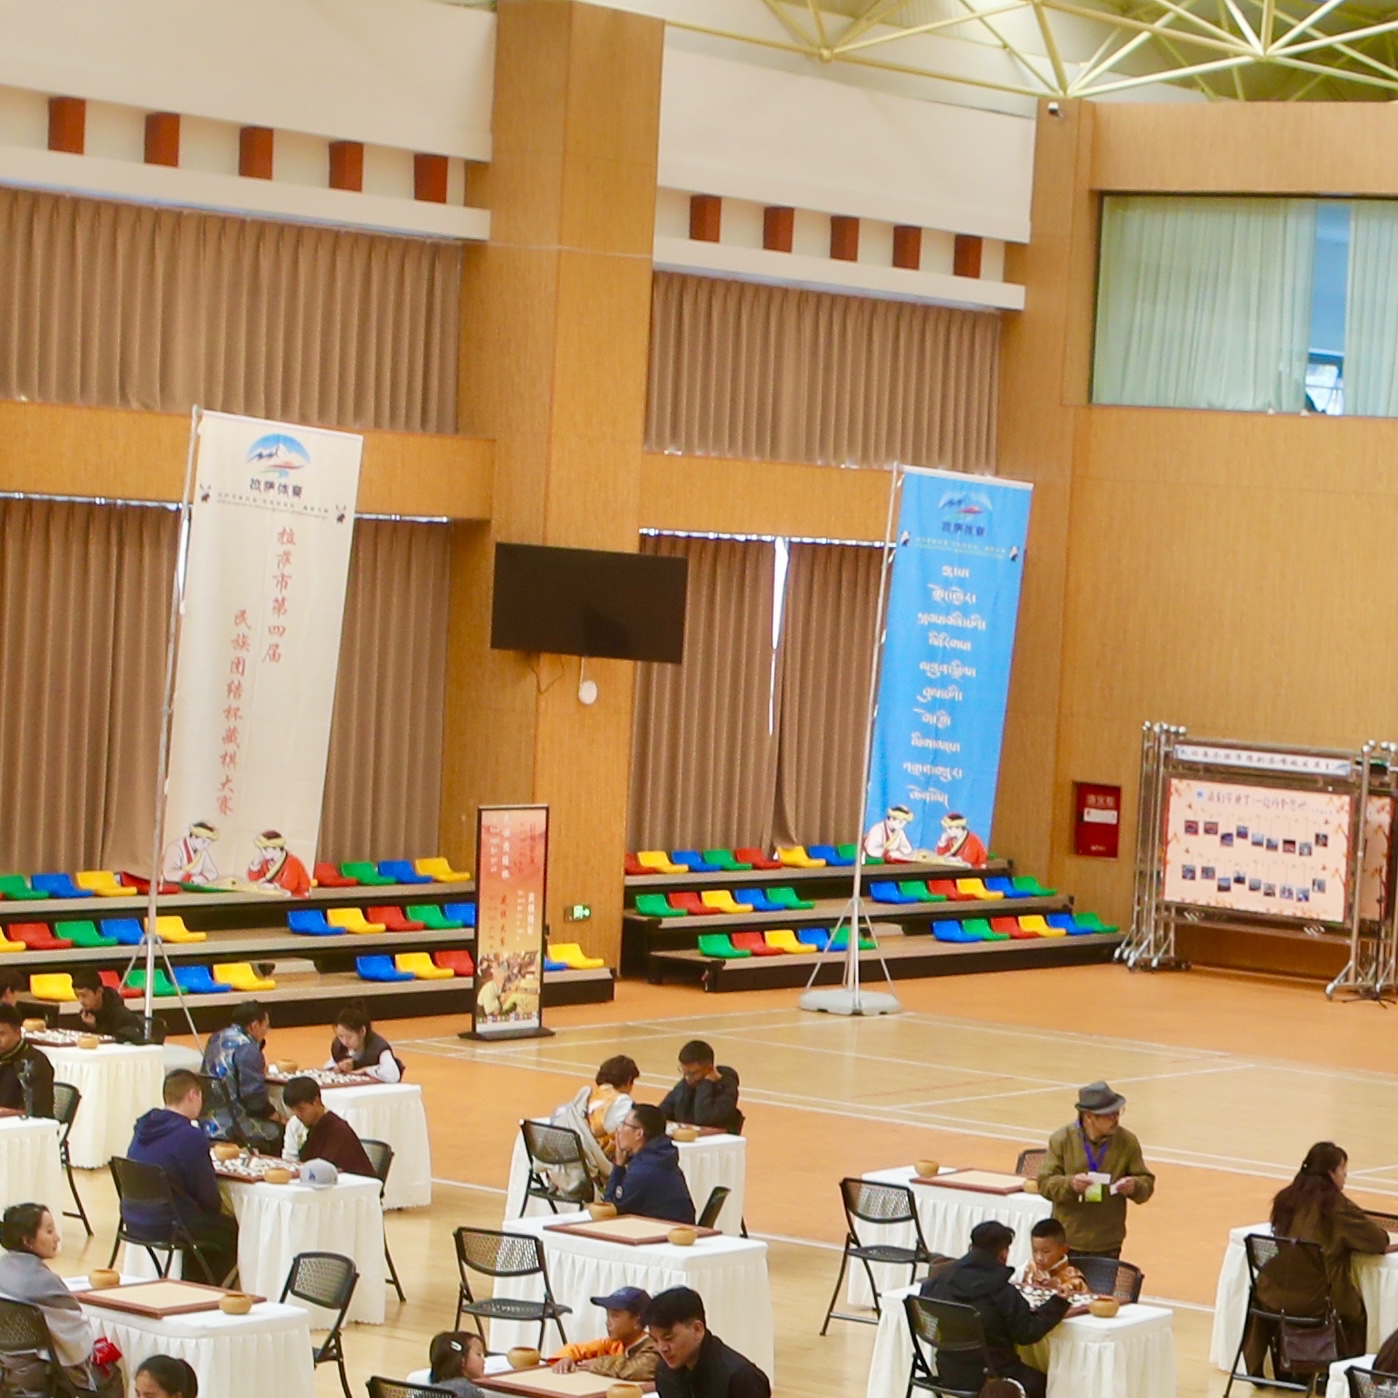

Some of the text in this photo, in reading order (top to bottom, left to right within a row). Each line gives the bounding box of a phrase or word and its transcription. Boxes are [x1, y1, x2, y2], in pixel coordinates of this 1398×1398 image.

[262, 526, 296, 663] 拉萨市第四届
